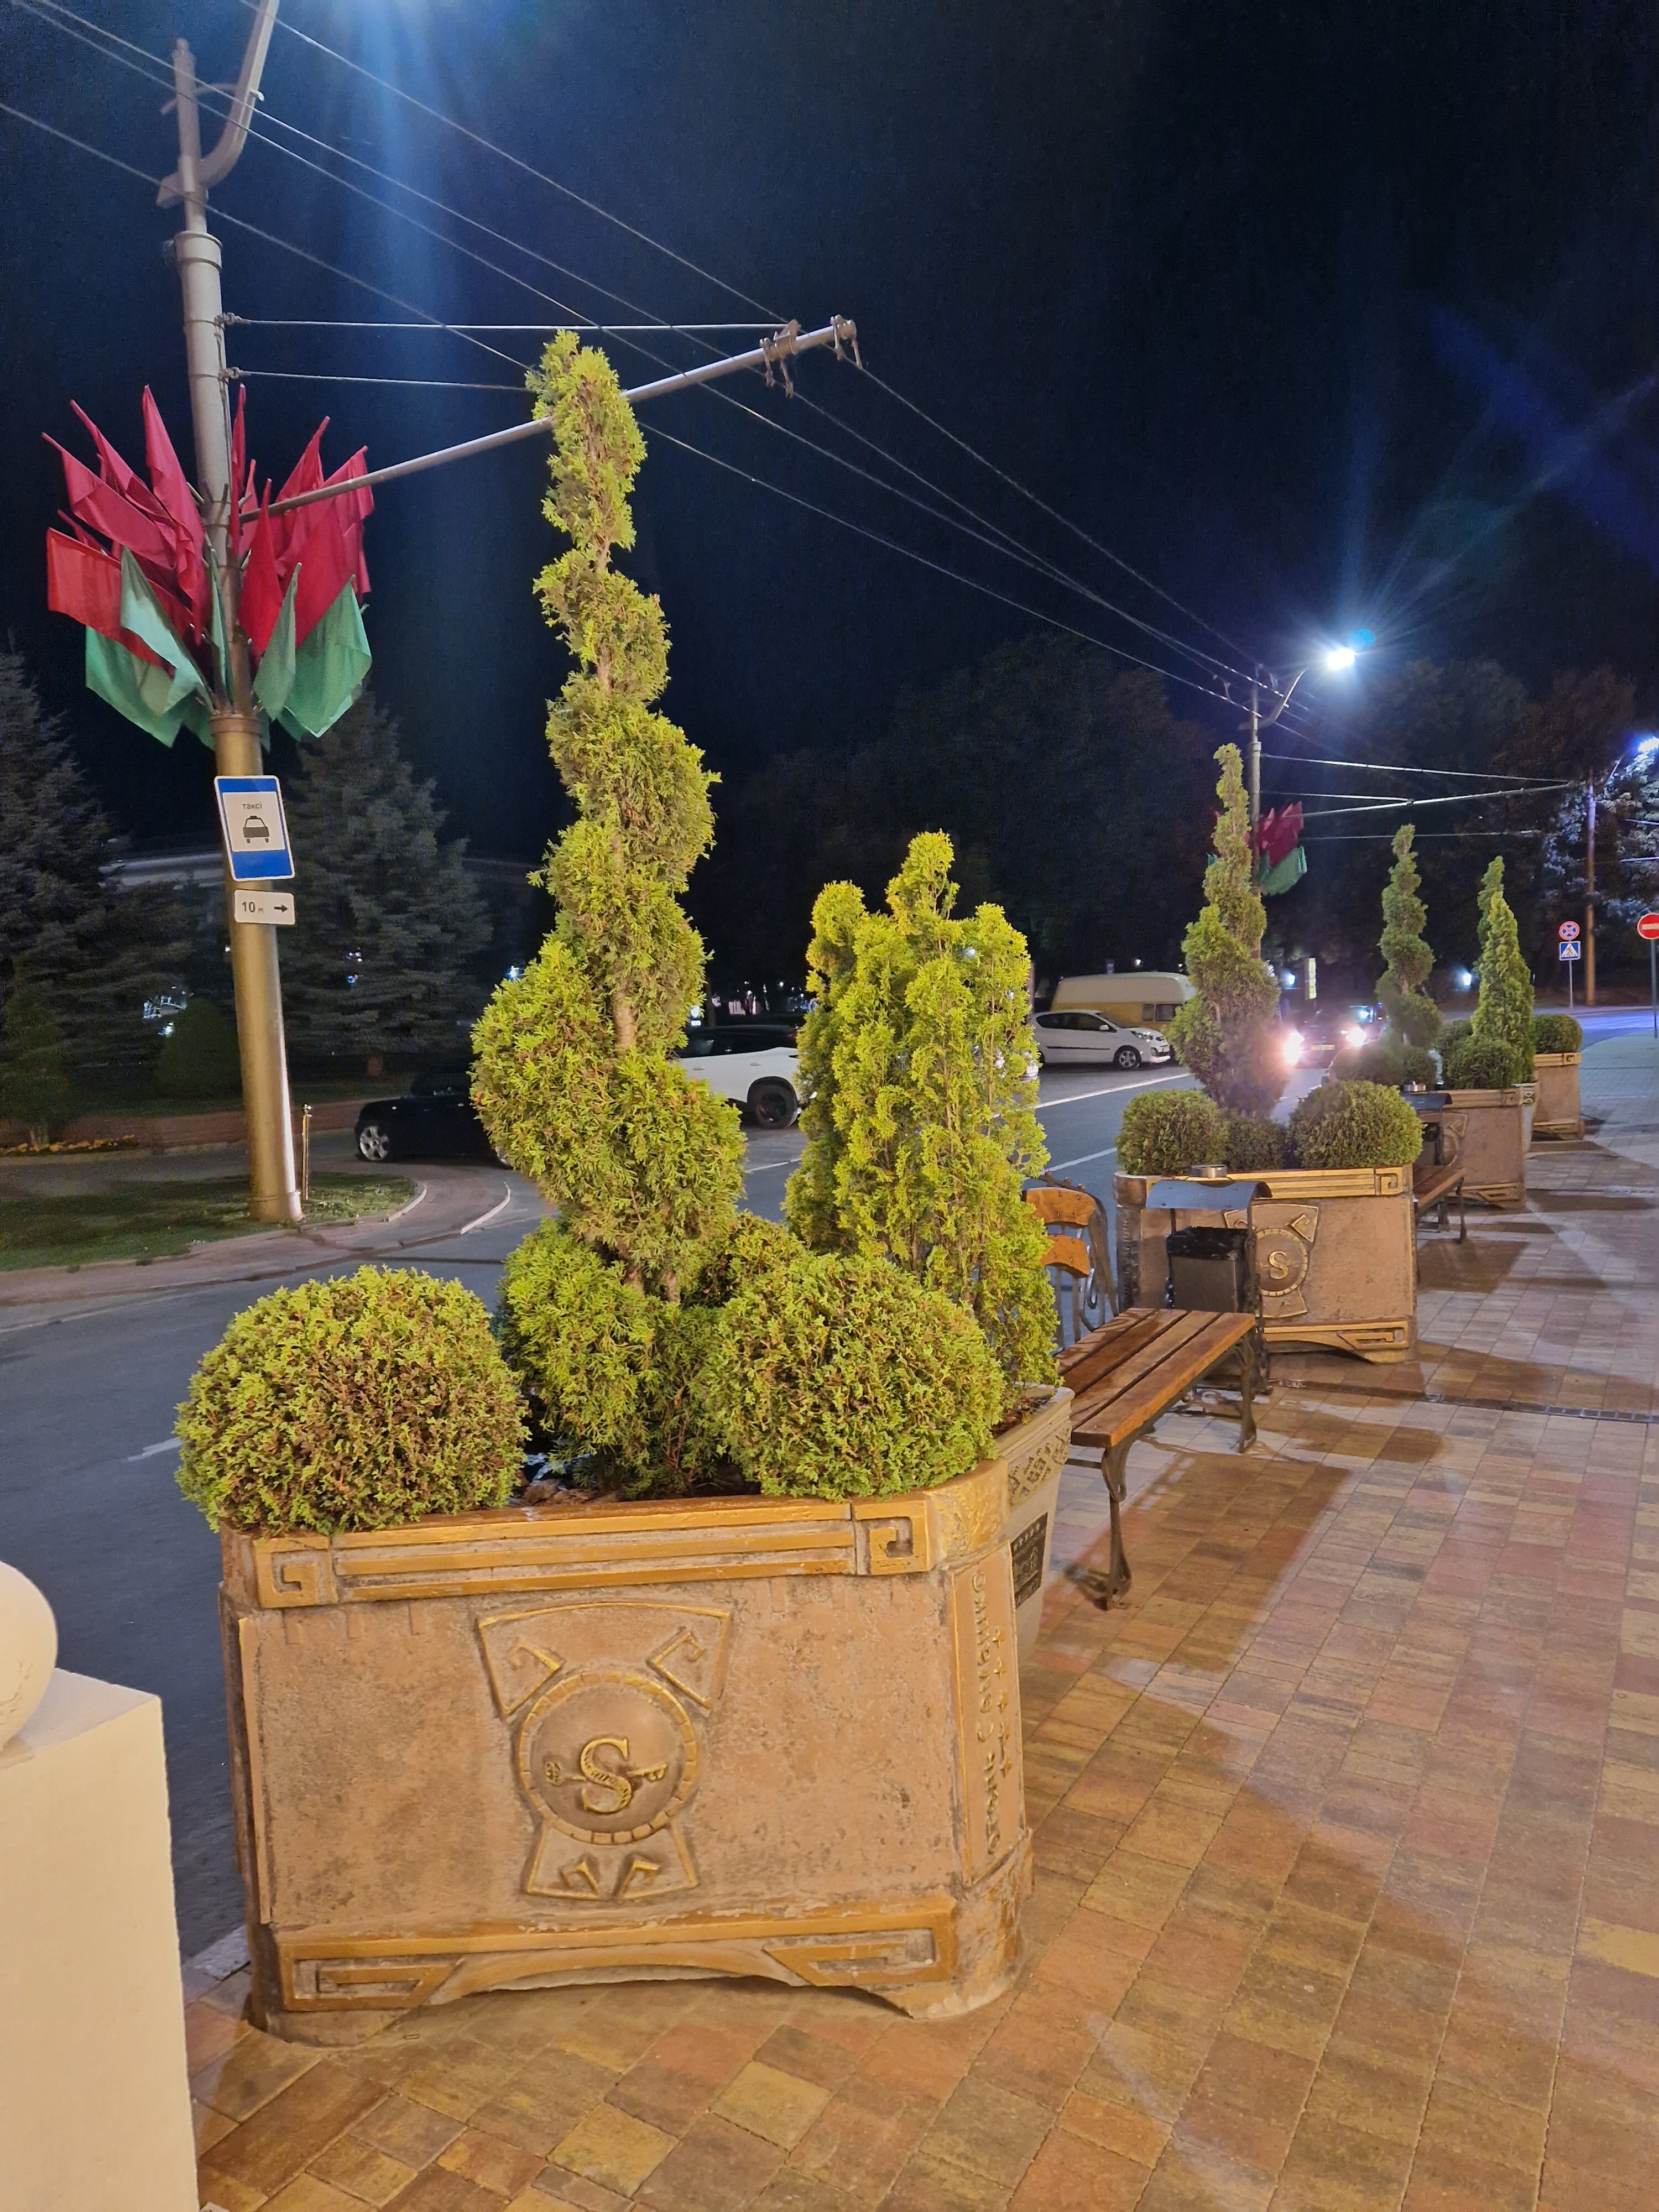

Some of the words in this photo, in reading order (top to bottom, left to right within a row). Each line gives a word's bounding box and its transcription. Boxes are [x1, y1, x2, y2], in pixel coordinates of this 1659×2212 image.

[242, 901, 255, 912] 10
[1269, 1251, 1288, 1279] S
[580, 1738, 632, 1813] S
